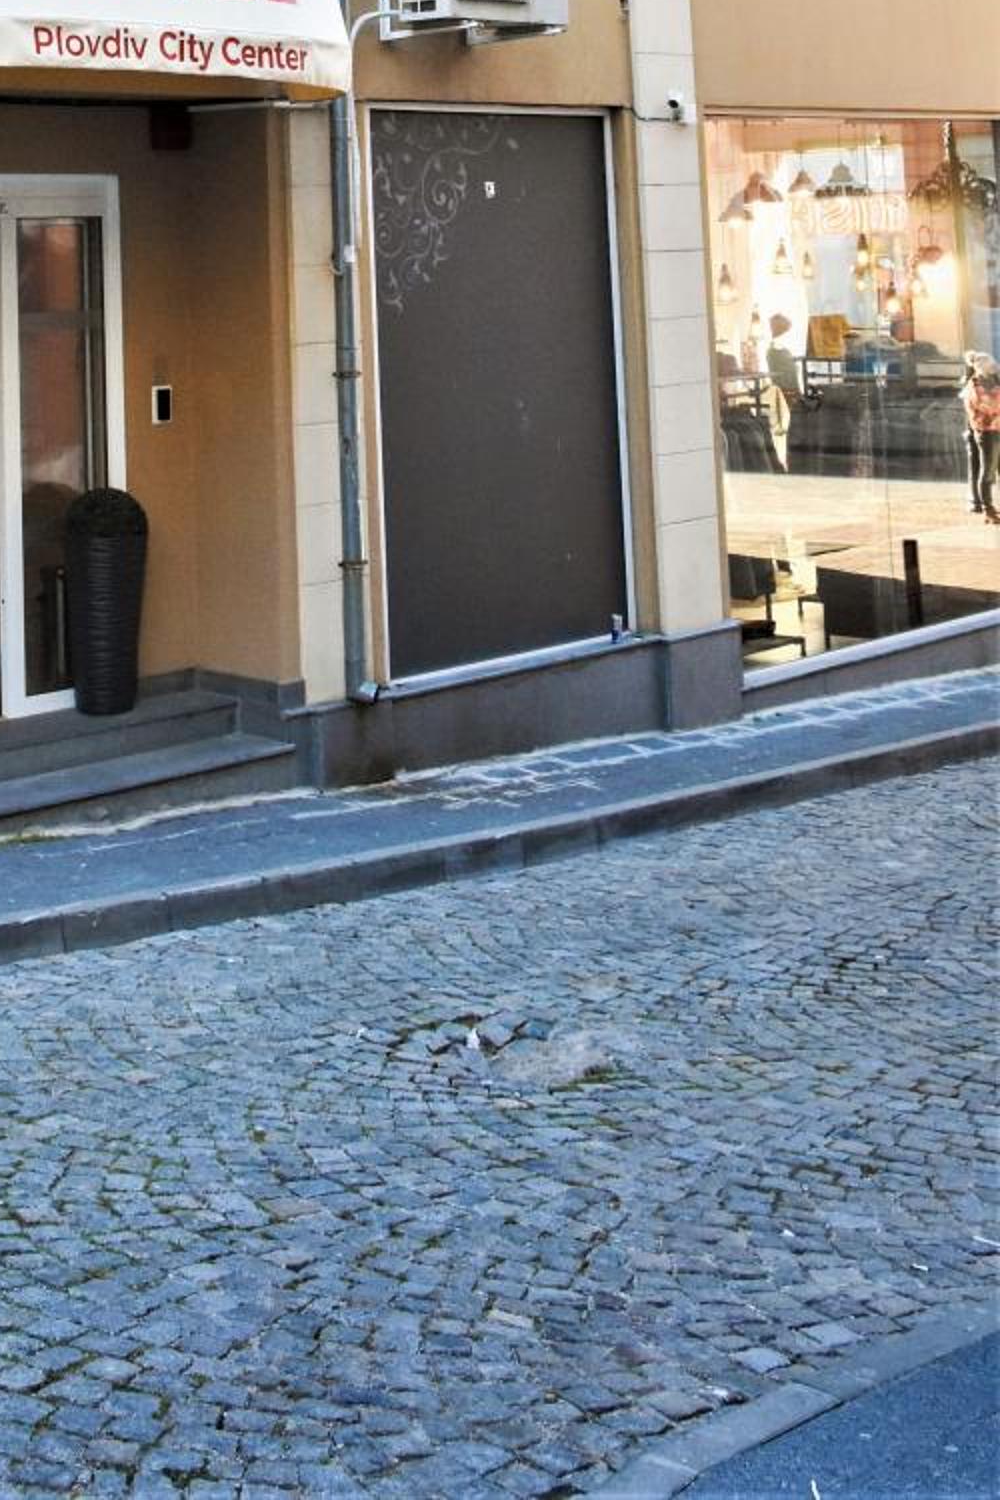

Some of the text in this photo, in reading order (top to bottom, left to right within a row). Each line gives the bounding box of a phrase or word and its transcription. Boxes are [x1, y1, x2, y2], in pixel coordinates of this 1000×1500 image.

[33, 25, 309, 72] Plovdiv City Center
